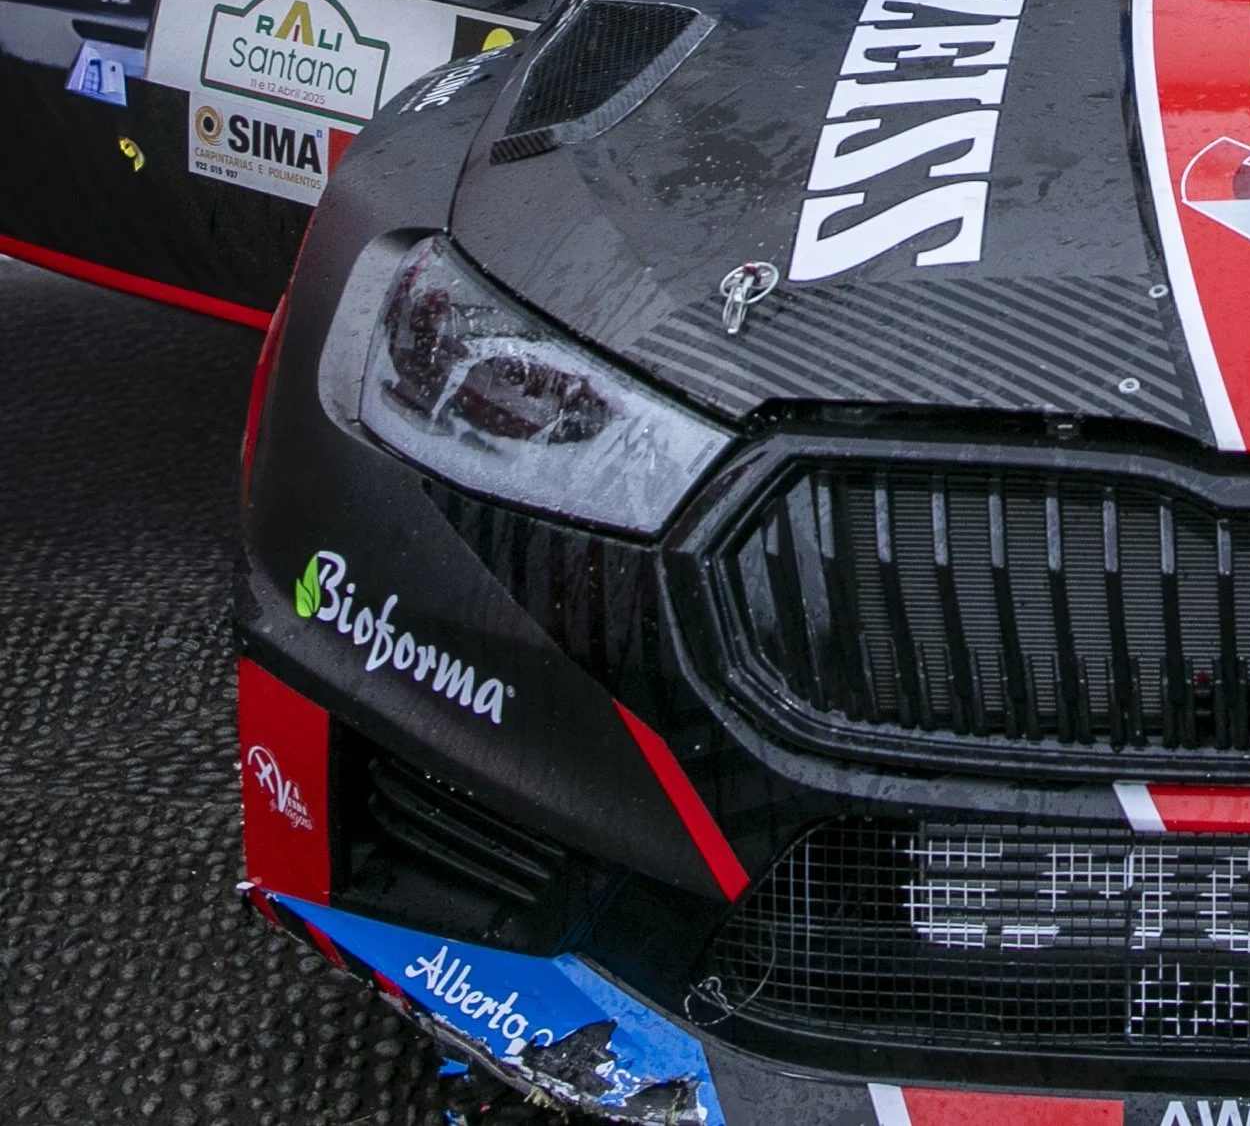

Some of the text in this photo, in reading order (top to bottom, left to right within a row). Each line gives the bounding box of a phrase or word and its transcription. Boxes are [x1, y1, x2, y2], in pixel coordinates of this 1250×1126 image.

[255, 0, 343, 53] RALI
[229, 36, 358, 95] Santana
[267, 82, 276, 93] 12
[278, 84, 301, 99] Abril
[303, 91, 326, 105] 2025
[194, 147, 254, 171] CARPINTARIAS
[228, 114, 322, 175] SIMA
[258, 164, 322, 190] E POLIMENTOS
[316, 550, 502, 724] Bioforma
[405, 945, 529, 1041] Alberto
